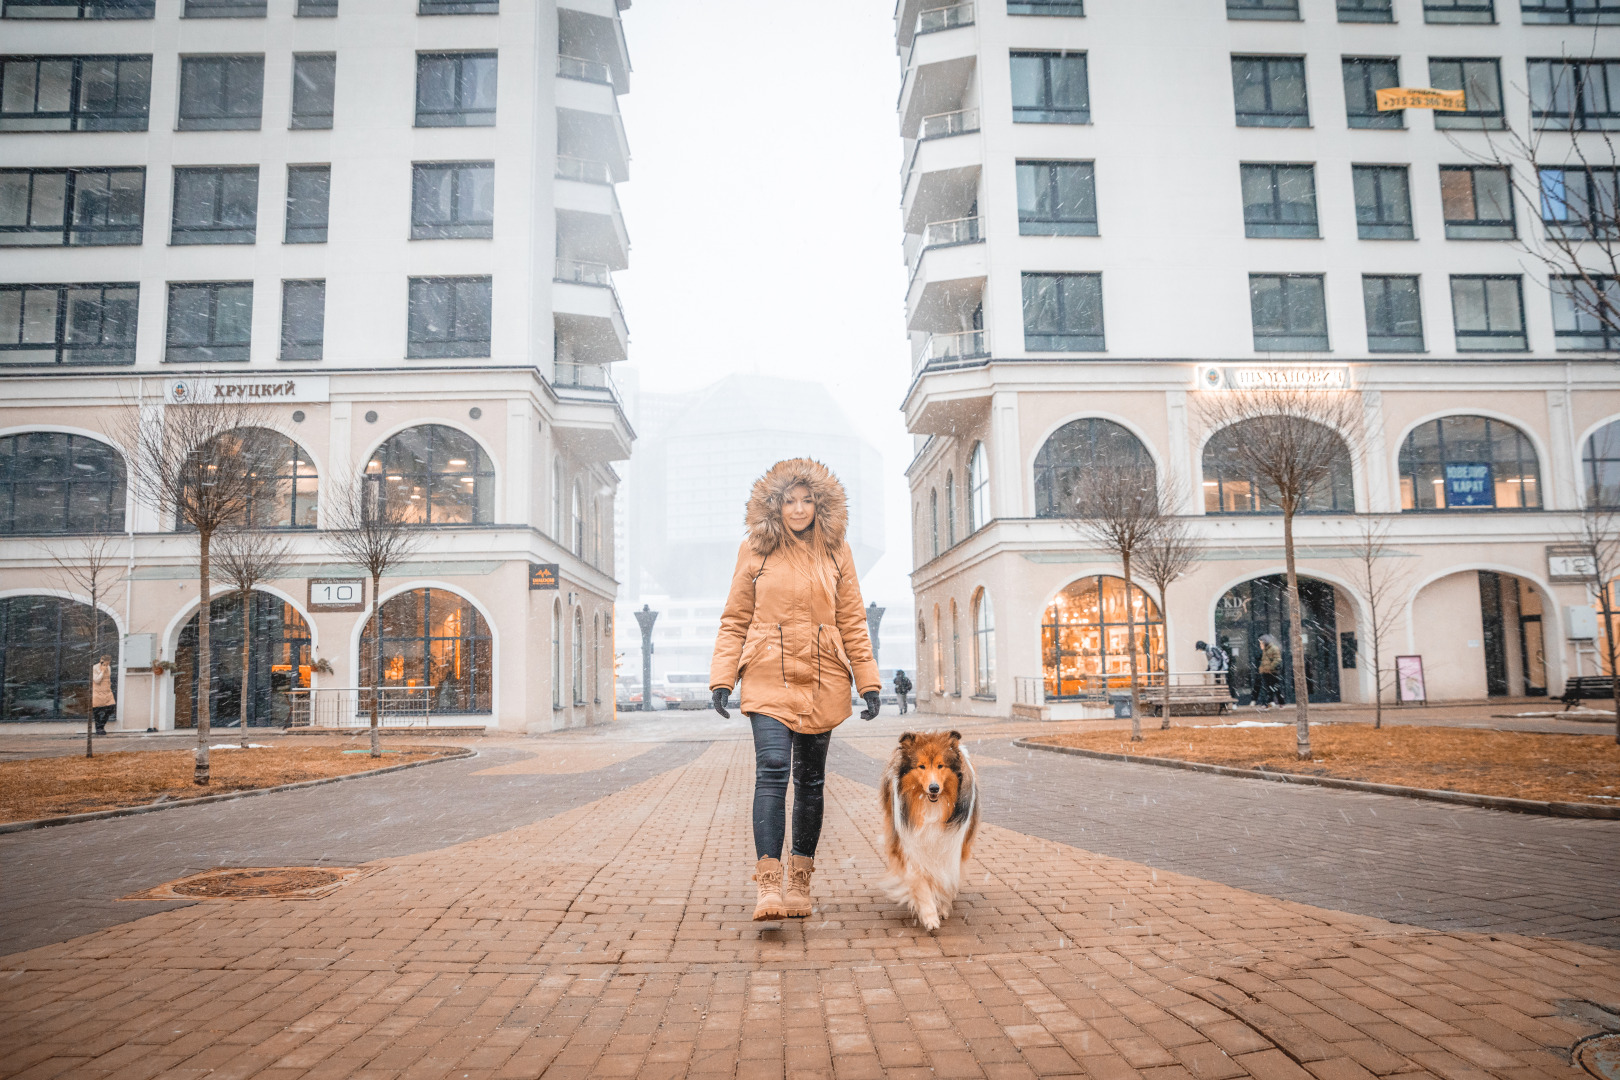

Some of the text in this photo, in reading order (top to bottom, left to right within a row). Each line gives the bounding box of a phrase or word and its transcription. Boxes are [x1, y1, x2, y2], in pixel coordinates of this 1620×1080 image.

[214, 380, 296, 398] ХРУЦКИЙ
[1452, 480, 1484, 493] КАРАТ
[323, 585, 353, 601] 10
